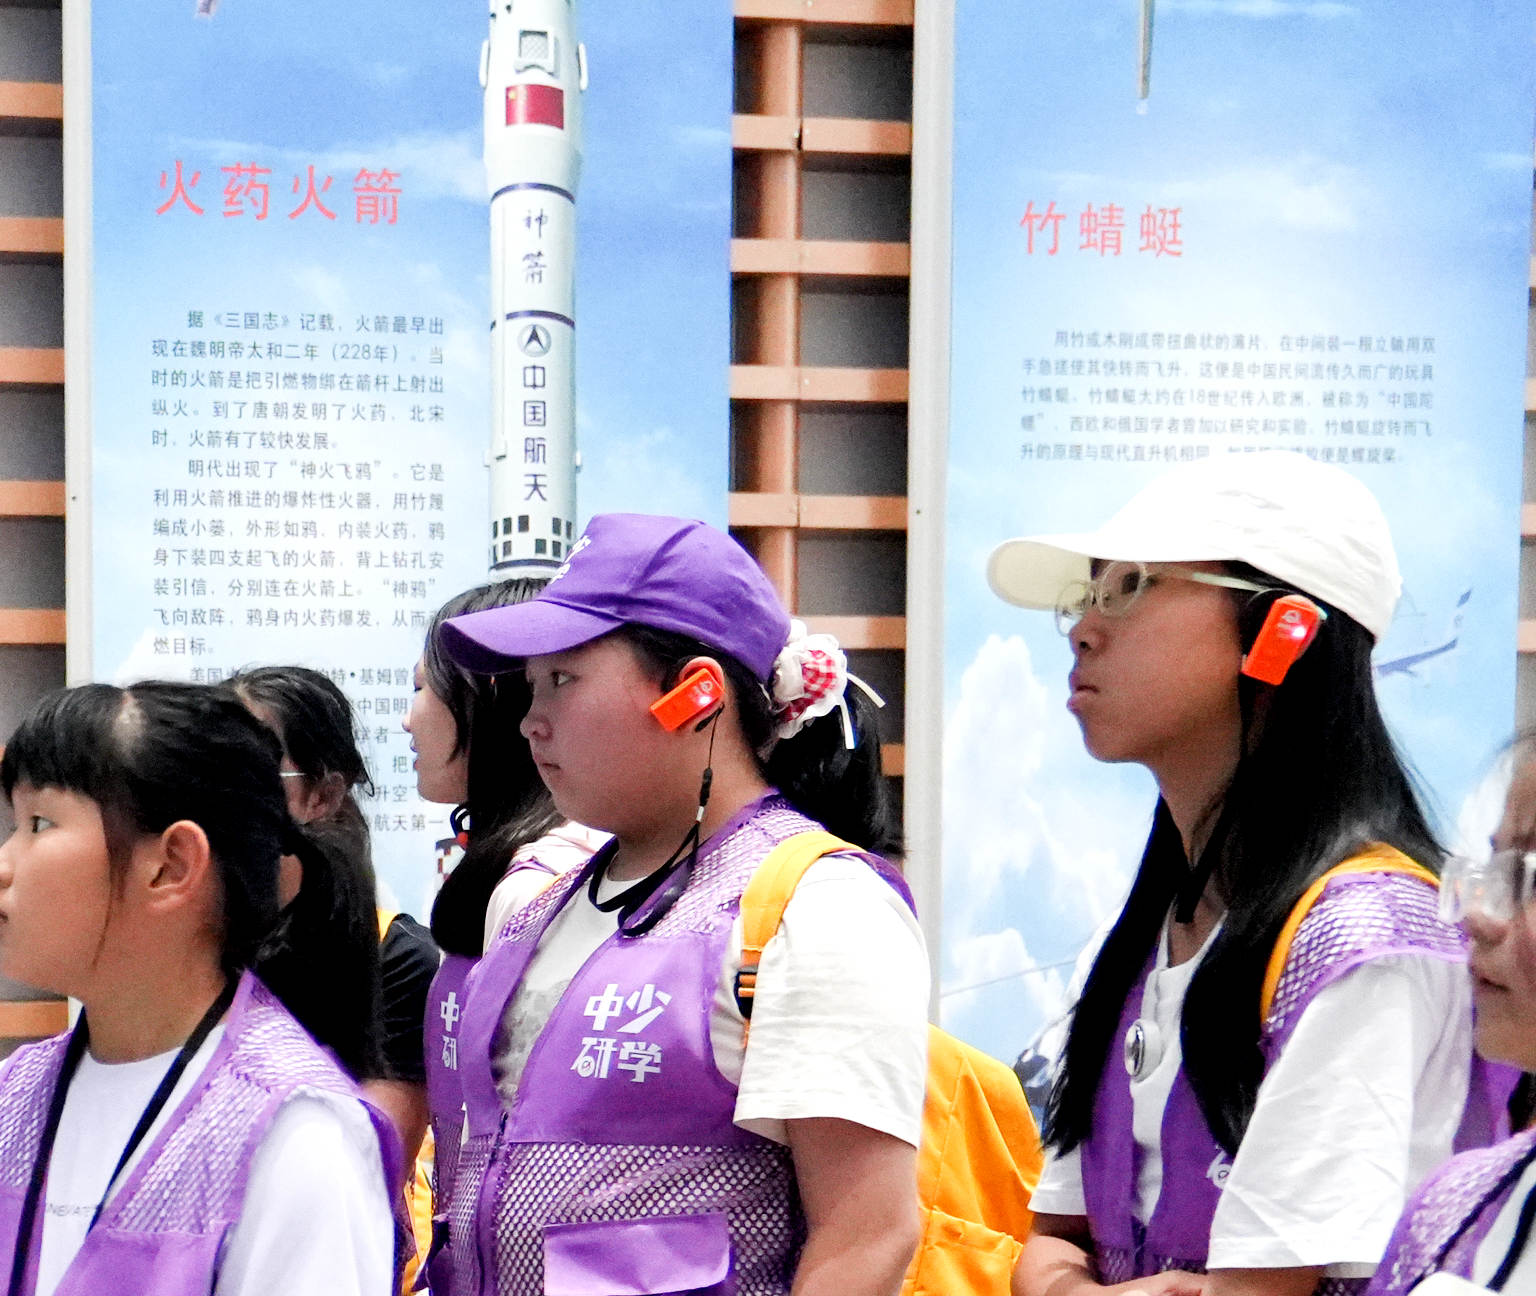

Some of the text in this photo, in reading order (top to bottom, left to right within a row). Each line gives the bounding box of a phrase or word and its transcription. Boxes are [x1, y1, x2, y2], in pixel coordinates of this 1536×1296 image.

[155, 160, 402, 224] 火药火箭
[1020, 200, 1183, 257] 竹蜻蜓
[523, 364, 548, 502] 中国航天
[153, 608, 436, 628] 飞向敌阵，鸦身内火药爆发，从而
[570, 1037, 662, 1083] 研学
